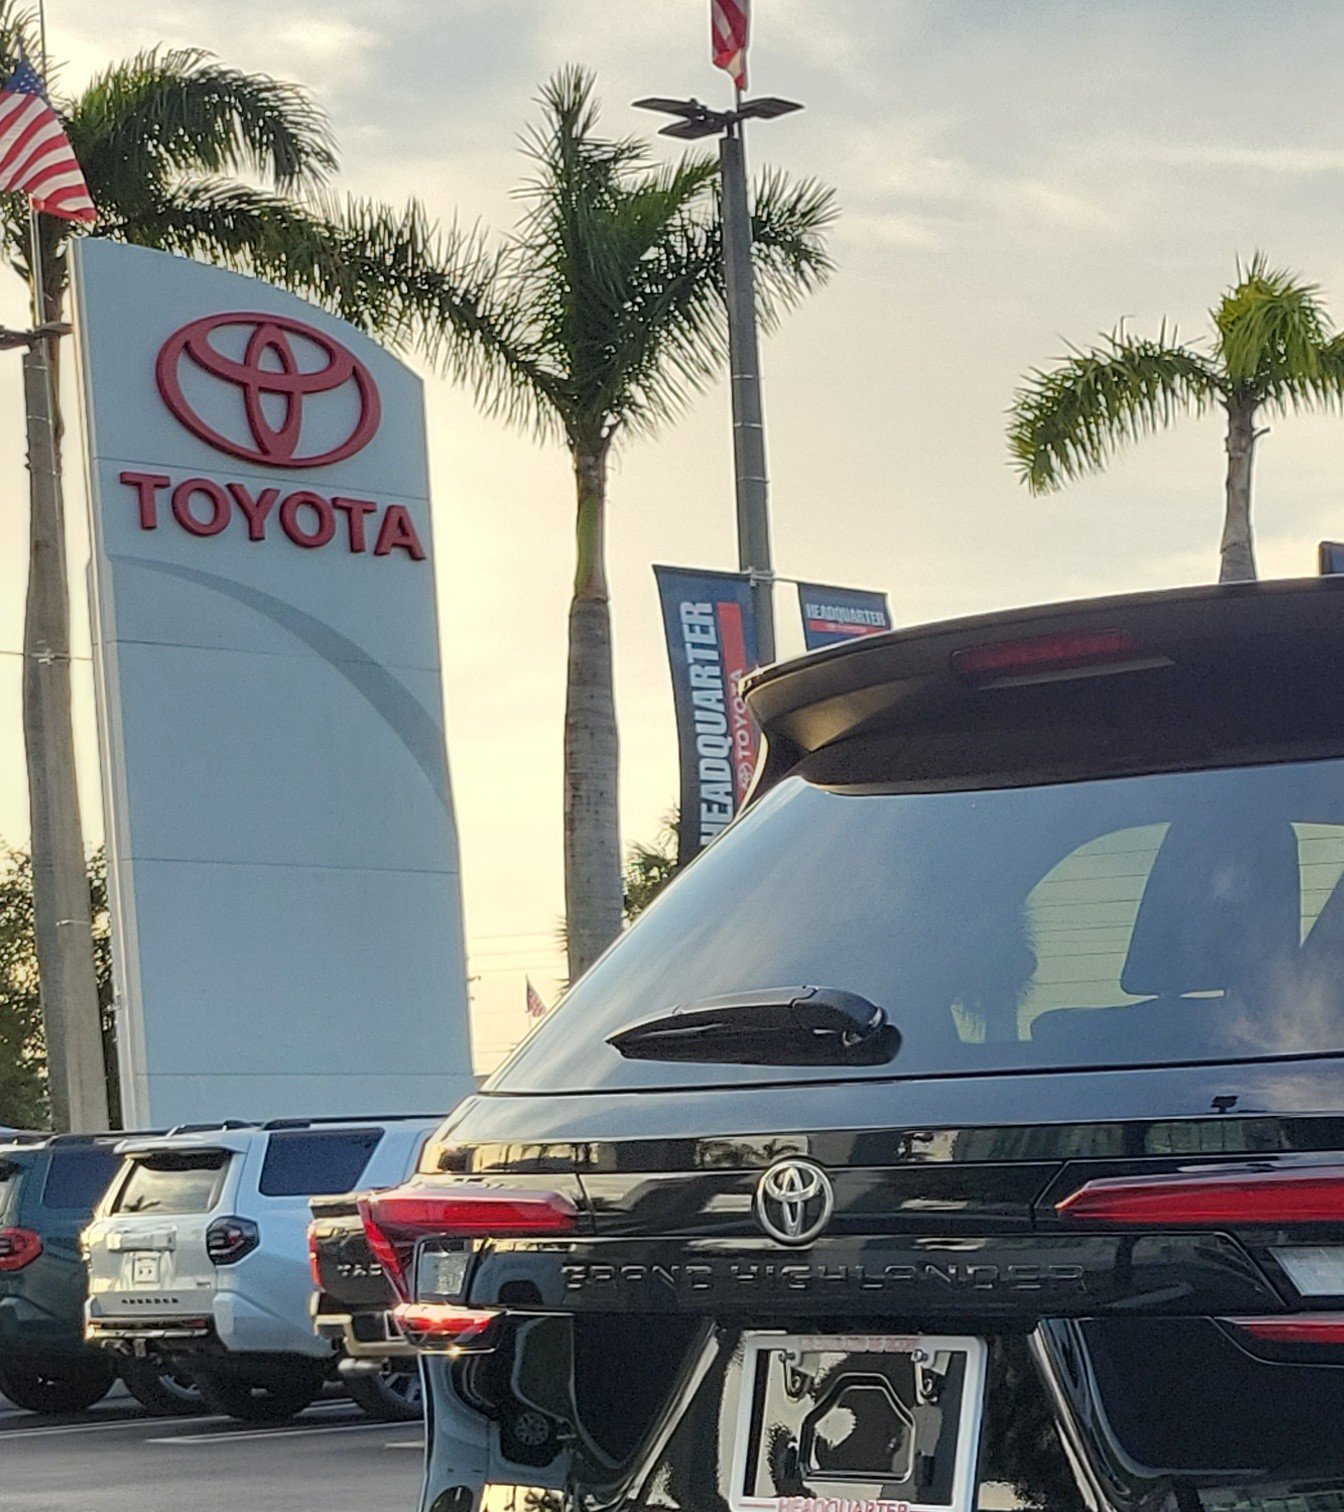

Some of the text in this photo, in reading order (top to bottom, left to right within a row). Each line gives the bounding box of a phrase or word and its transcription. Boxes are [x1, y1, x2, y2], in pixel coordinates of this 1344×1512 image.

[119, 471, 427, 561] TOYOTA
[560, 1265, 1088, 1293] GRAND HIGHLANDER
